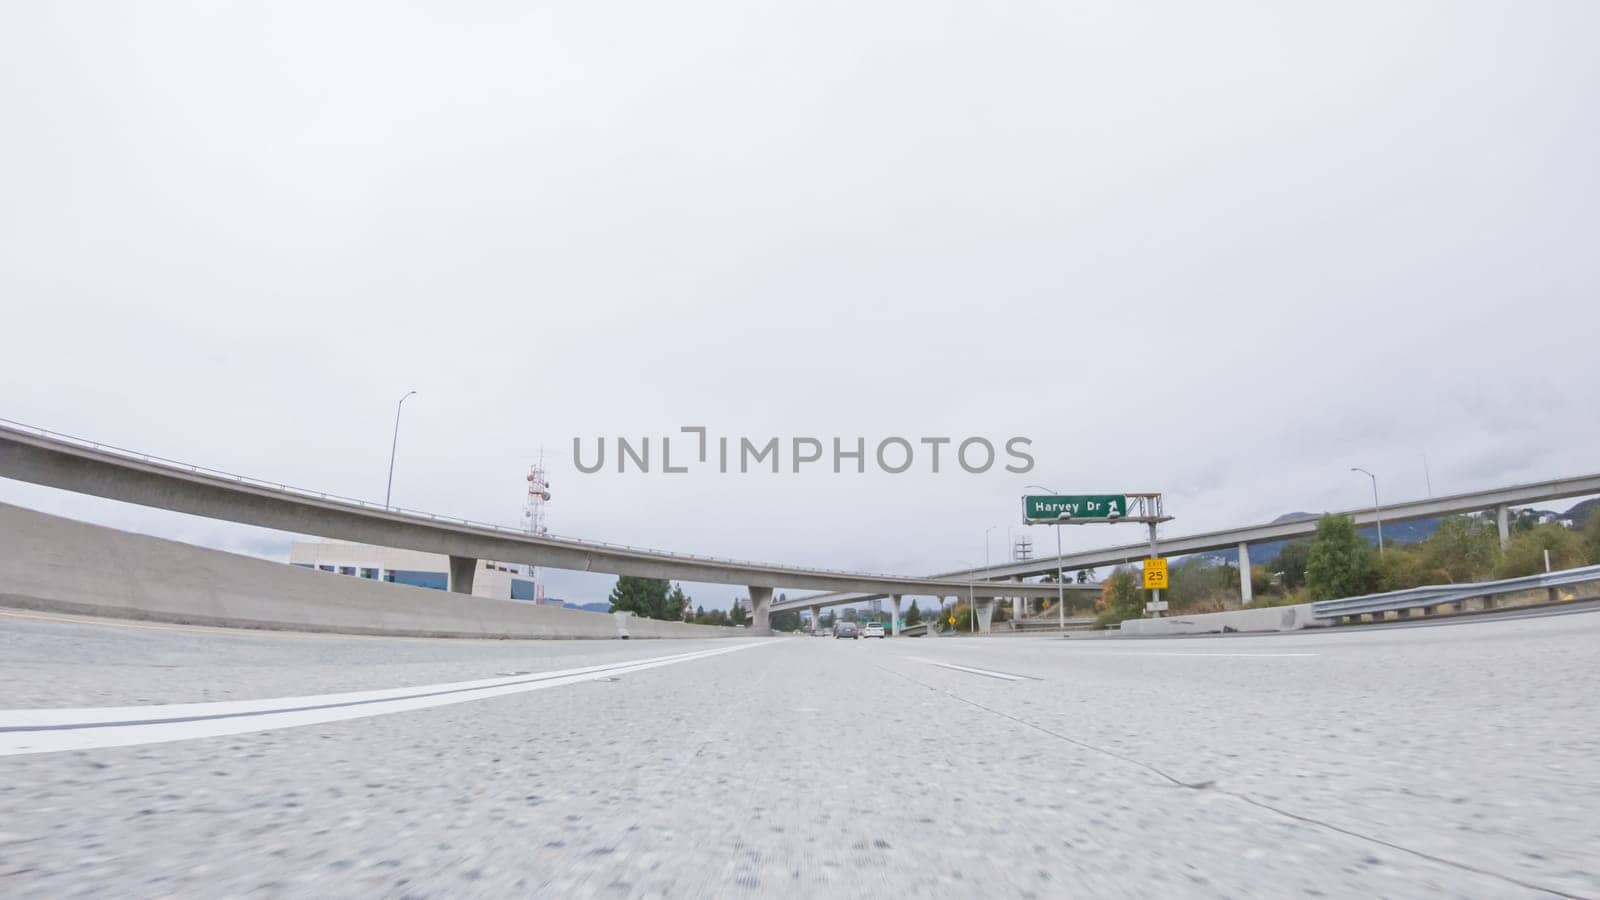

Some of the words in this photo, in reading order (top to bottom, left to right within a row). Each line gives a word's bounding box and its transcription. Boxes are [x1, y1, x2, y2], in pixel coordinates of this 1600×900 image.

[1035, 502, 1079, 513] Harvey
[1087, 501, 1101, 511] Dr
[1148, 571, 1163, 581] 25
